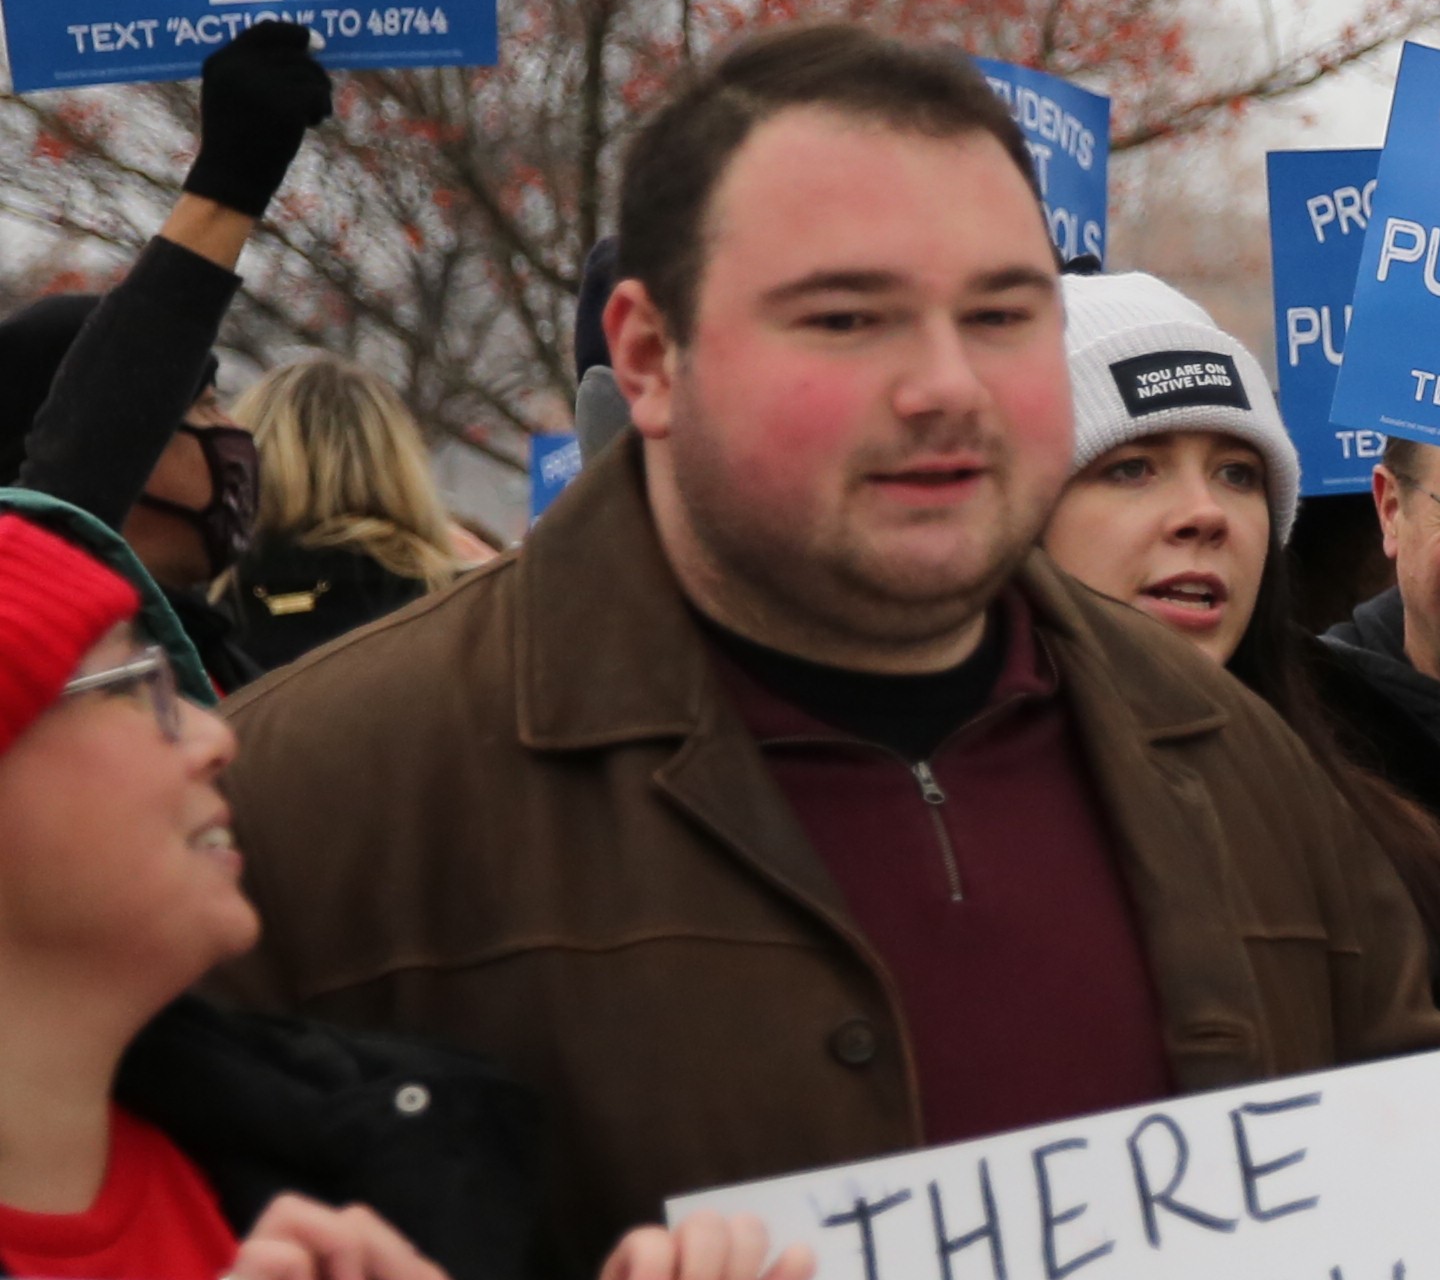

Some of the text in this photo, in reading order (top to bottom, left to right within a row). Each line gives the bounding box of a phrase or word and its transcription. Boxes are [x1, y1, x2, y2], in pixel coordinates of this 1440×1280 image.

[67, 19, 159, 54] TEXT
[321, 11, 361, 37] TO
[366, 8, 448, 36] 48744
[1136, 363, 1227, 385] YOU ARE ON
[1137, 375, 1232, 398] NATIVE LAND
